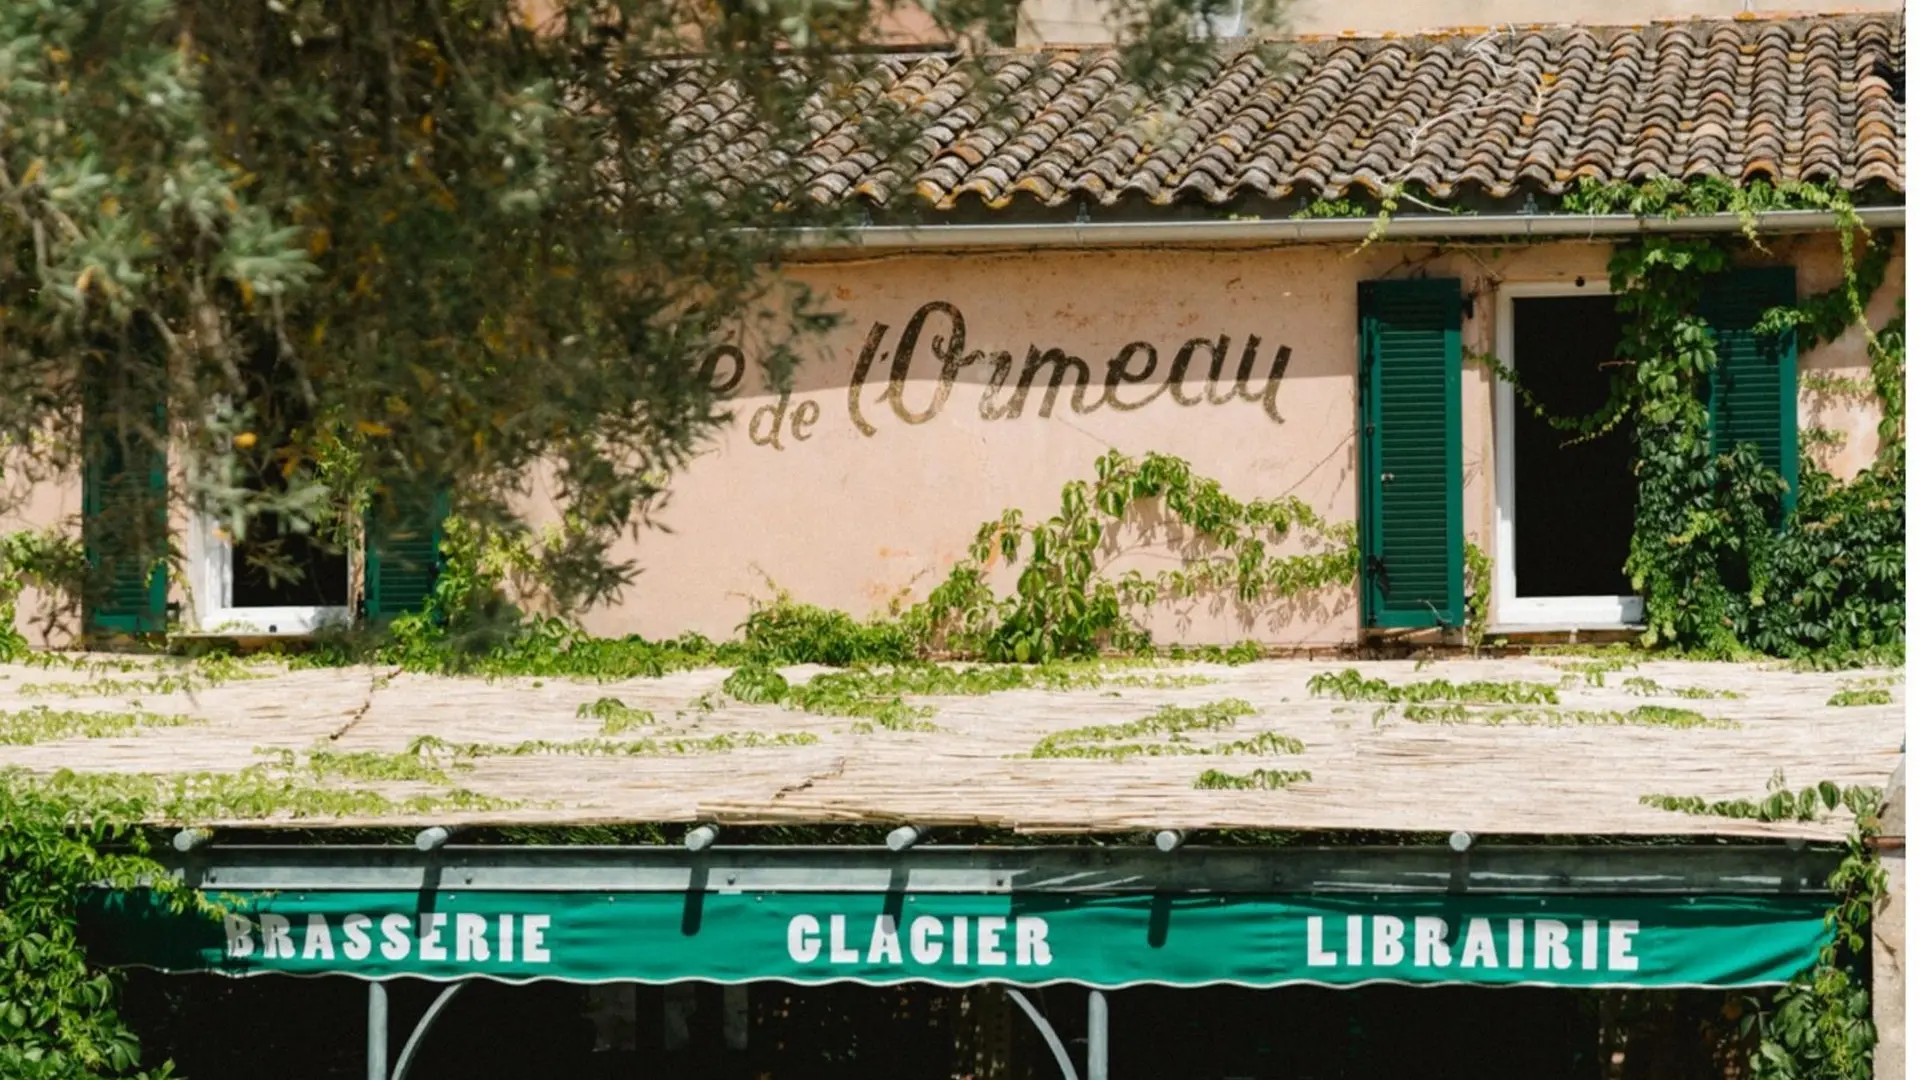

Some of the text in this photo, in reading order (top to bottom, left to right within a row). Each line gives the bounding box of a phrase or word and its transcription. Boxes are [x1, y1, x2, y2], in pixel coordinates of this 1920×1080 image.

[749, 390, 821, 451] de
[225, 913, 551, 962] BRASSERIE
[788, 914, 1051, 965] GLACIER
[1308, 915, 1640, 970] LIBRAIRIE
